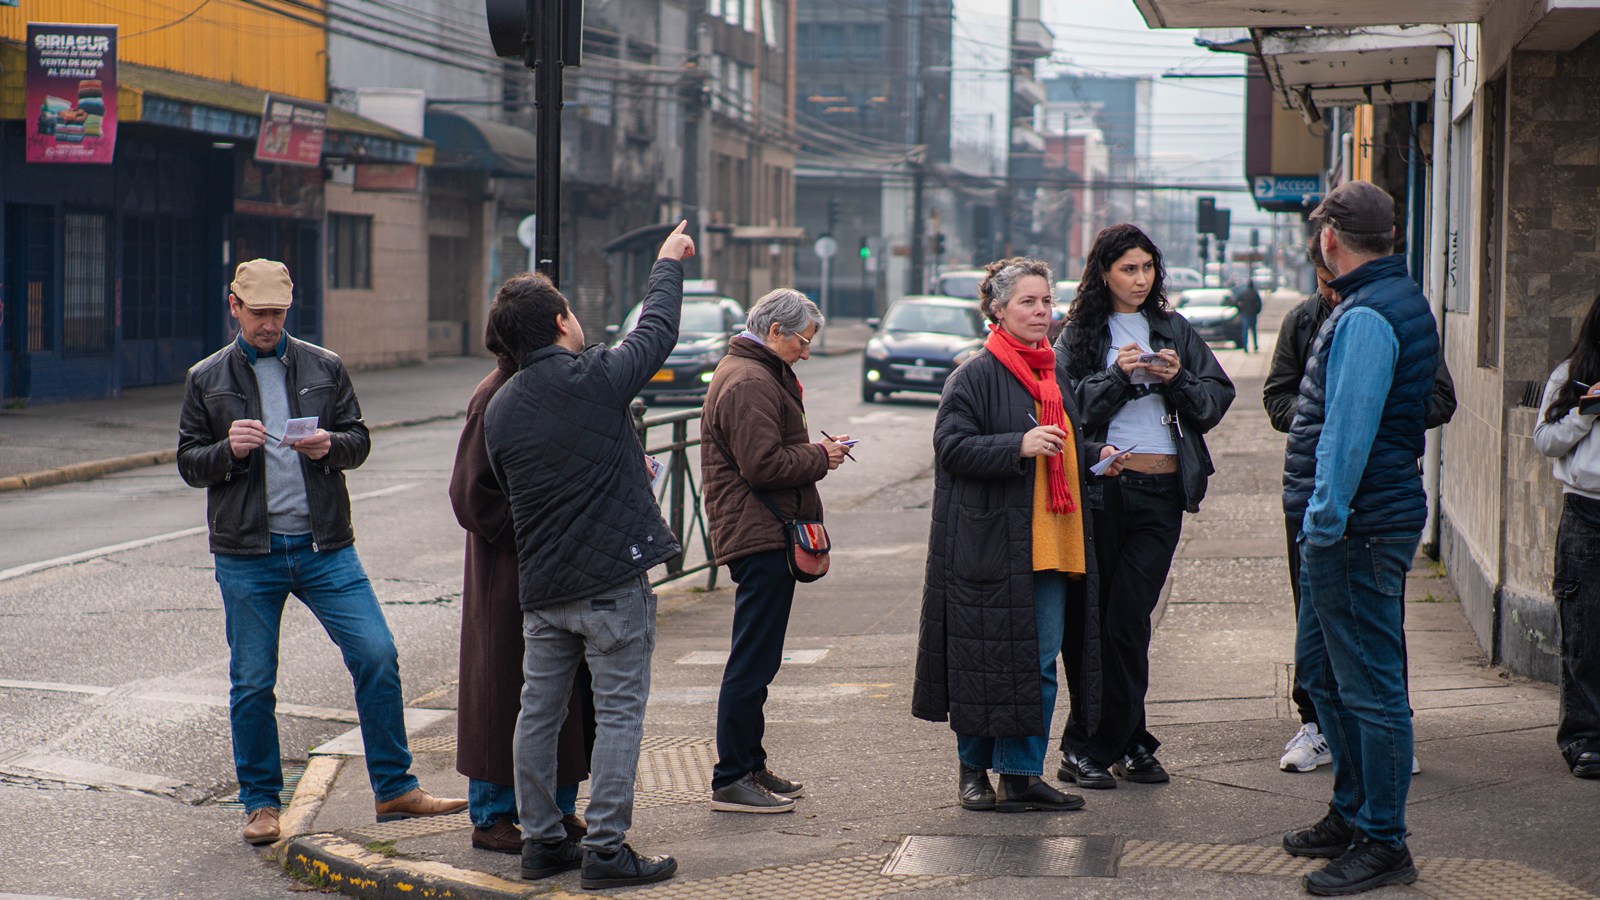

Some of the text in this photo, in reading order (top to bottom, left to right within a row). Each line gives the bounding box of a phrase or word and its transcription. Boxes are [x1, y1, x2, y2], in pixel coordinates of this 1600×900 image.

[34, 34, 110, 52] SIRIASUR
[40, 58, 104, 68] VENTA DE ROPA
[48, 68, 97, 77] AL DETALLE
[1275, 180, 1316, 191] ACCESO
